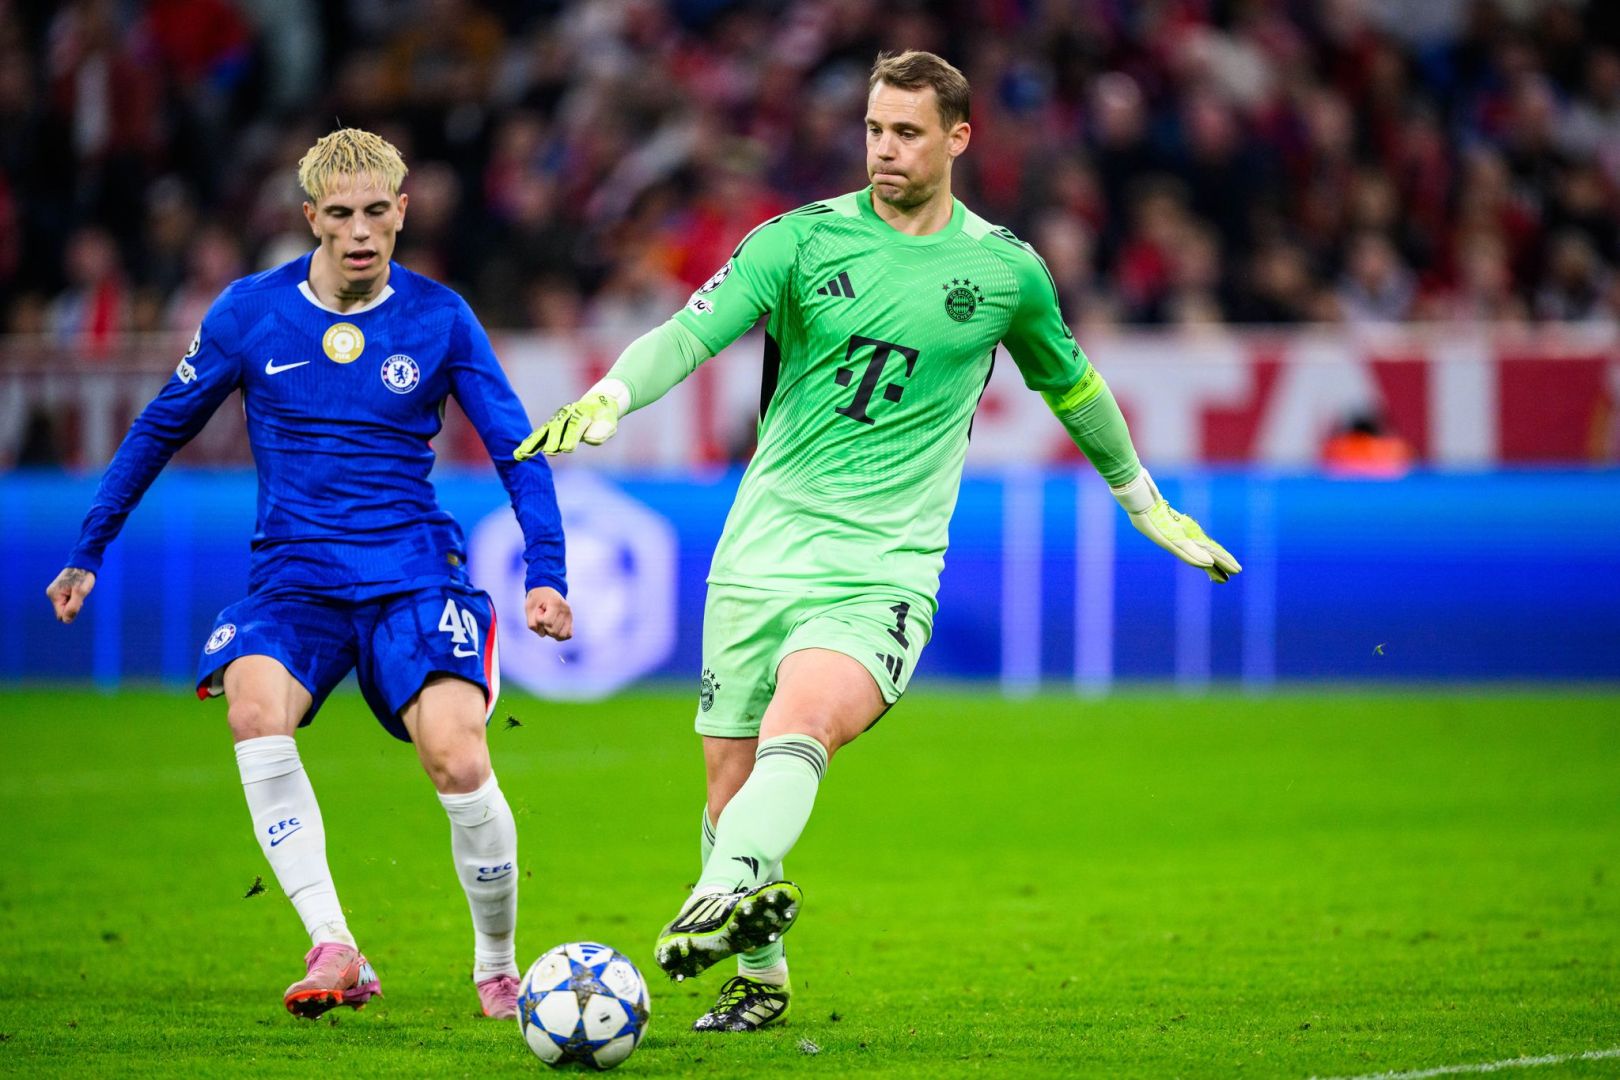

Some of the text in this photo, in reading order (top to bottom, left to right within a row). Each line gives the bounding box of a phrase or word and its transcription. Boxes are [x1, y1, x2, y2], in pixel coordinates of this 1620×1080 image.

[834, 334, 920, 426] T
[438, 598, 479, 652] 49
[888, 601, 911, 650] 1
[268, 817, 300, 835] CFC
[478, 862, 512, 874] CFC
